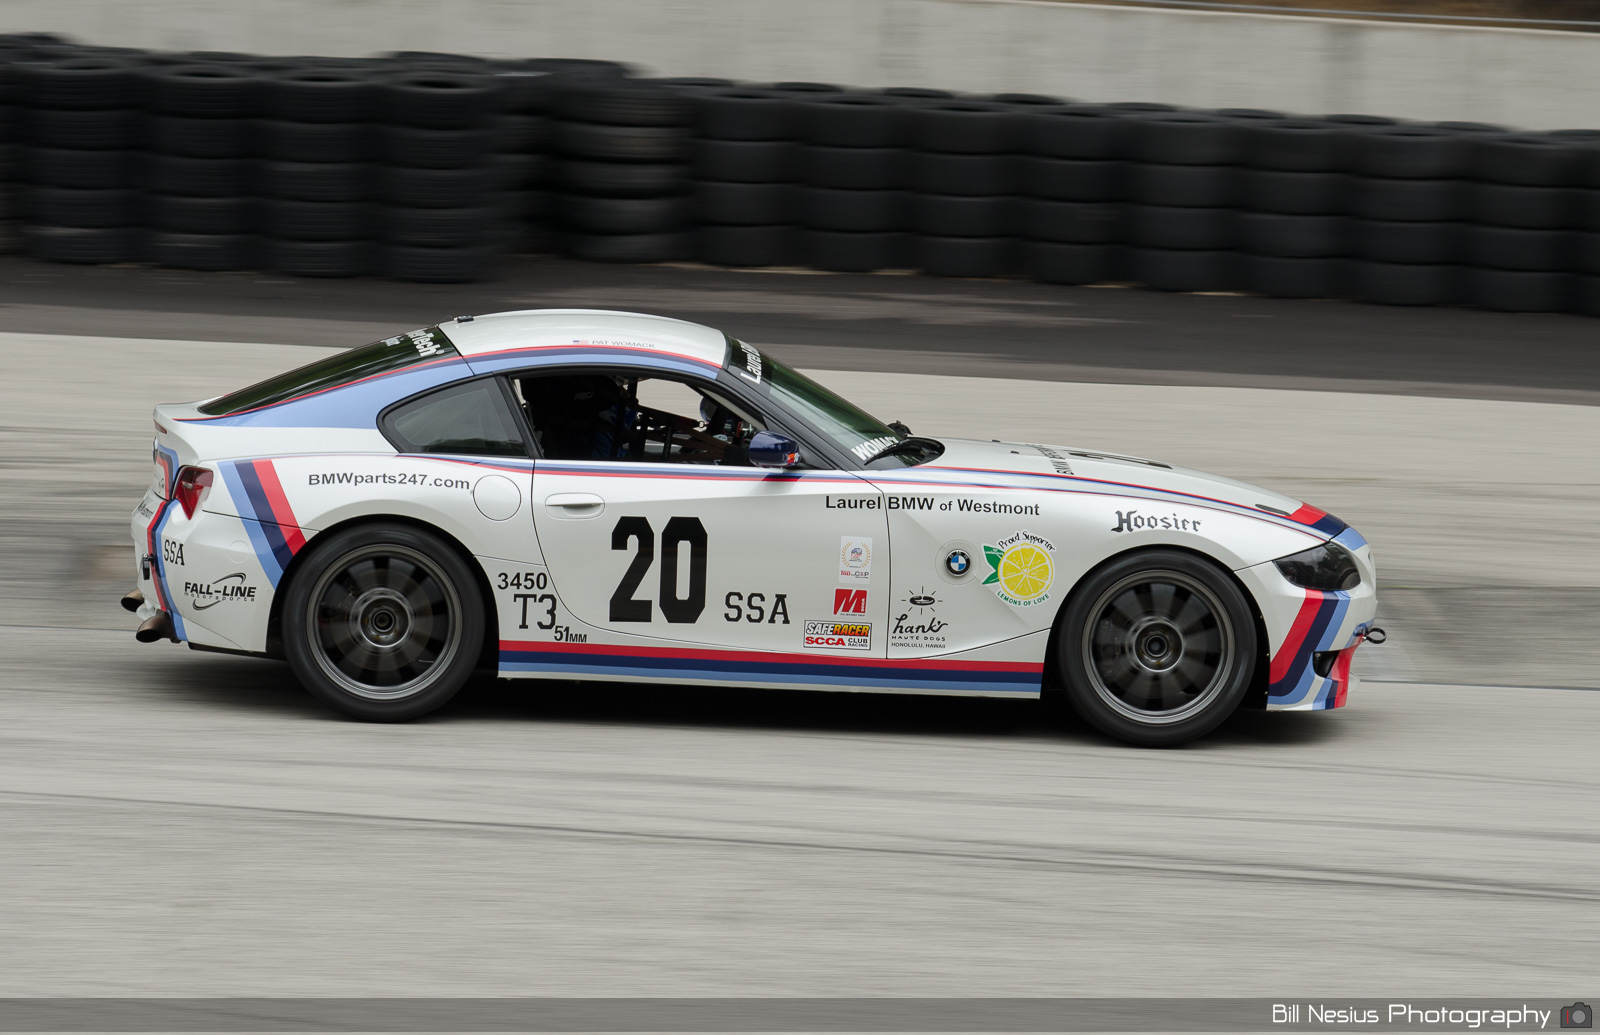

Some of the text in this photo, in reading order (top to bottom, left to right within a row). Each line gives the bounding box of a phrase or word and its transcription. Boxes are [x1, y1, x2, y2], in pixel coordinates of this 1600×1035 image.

[611, 340, 656, 348] WOMACK
[308, 472, 470, 490] BMWparts247.com
[825, 495, 1040, 516] Laurel BMW of Westmont
[1110, 510, 1202, 533] Hoosier
[998, 530, 1056, 551] Proud Supporter
[163, 538, 185, 566] SSA
[609, 516, 708, 624] 20
[184, 581, 257, 598] FALL-LINE
[497, 572, 547, 590] 3450
[184, 591, 255, 602] motorsports
[997, 590, 1021, 606] LEMONS
[1033, 593, 1050, 605] LOVE
[513, 593, 558, 630] T3
[723, 591, 791, 625] SSA
[892, 613, 949, 634] hank's
[554, 625, 587, 643] 51MM
[805, 636, 846, 646] SCCA
